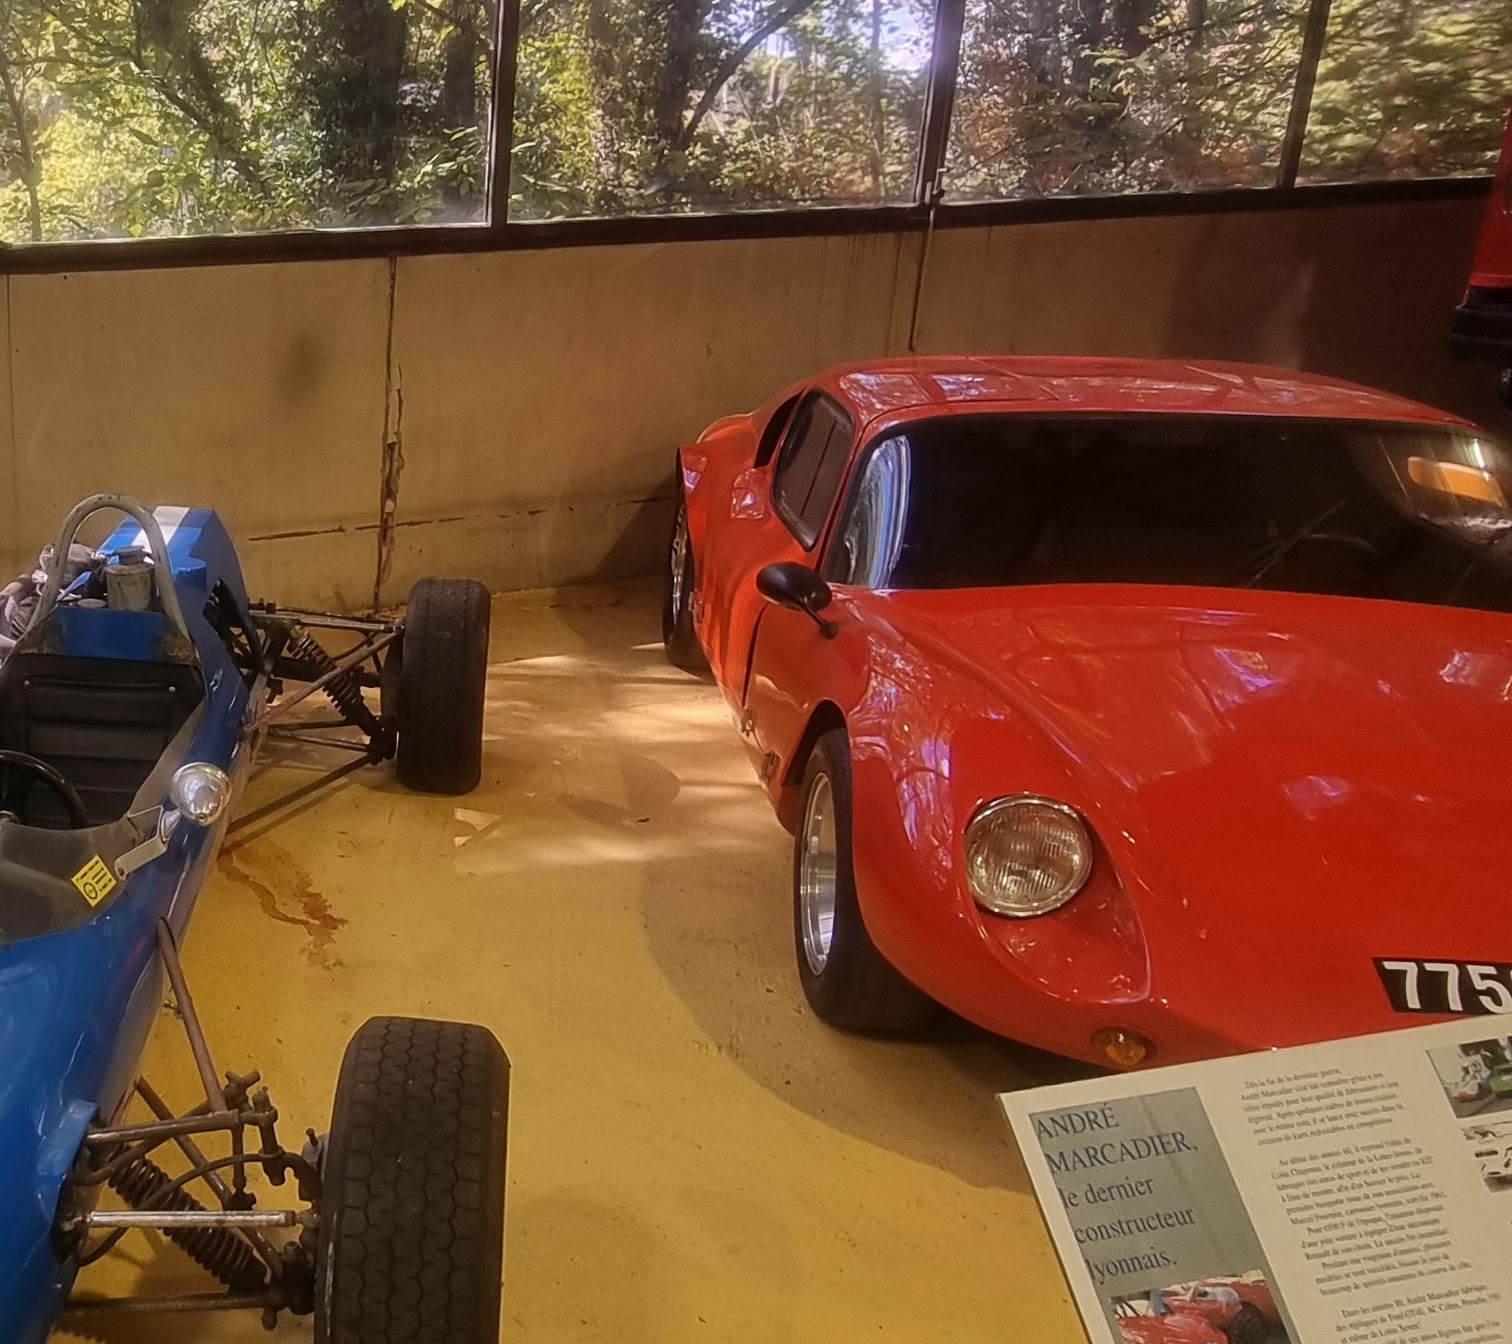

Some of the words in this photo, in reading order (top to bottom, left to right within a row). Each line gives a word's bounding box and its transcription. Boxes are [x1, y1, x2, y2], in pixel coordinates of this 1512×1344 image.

[1382, 961, 1512, 1014] 775
[1037, 1102, 1120, 1139] ANDRÉ
[1044, 1131, 1199, 1174] MARCADIER,
[1058, 1187, 1080, 1209] le
[1084, 1176, 1155, 1205] dernier
[1074, 1208, 1196, 1244] constructeur
[1086, 1246, 1178, 1285] lyonnais.
